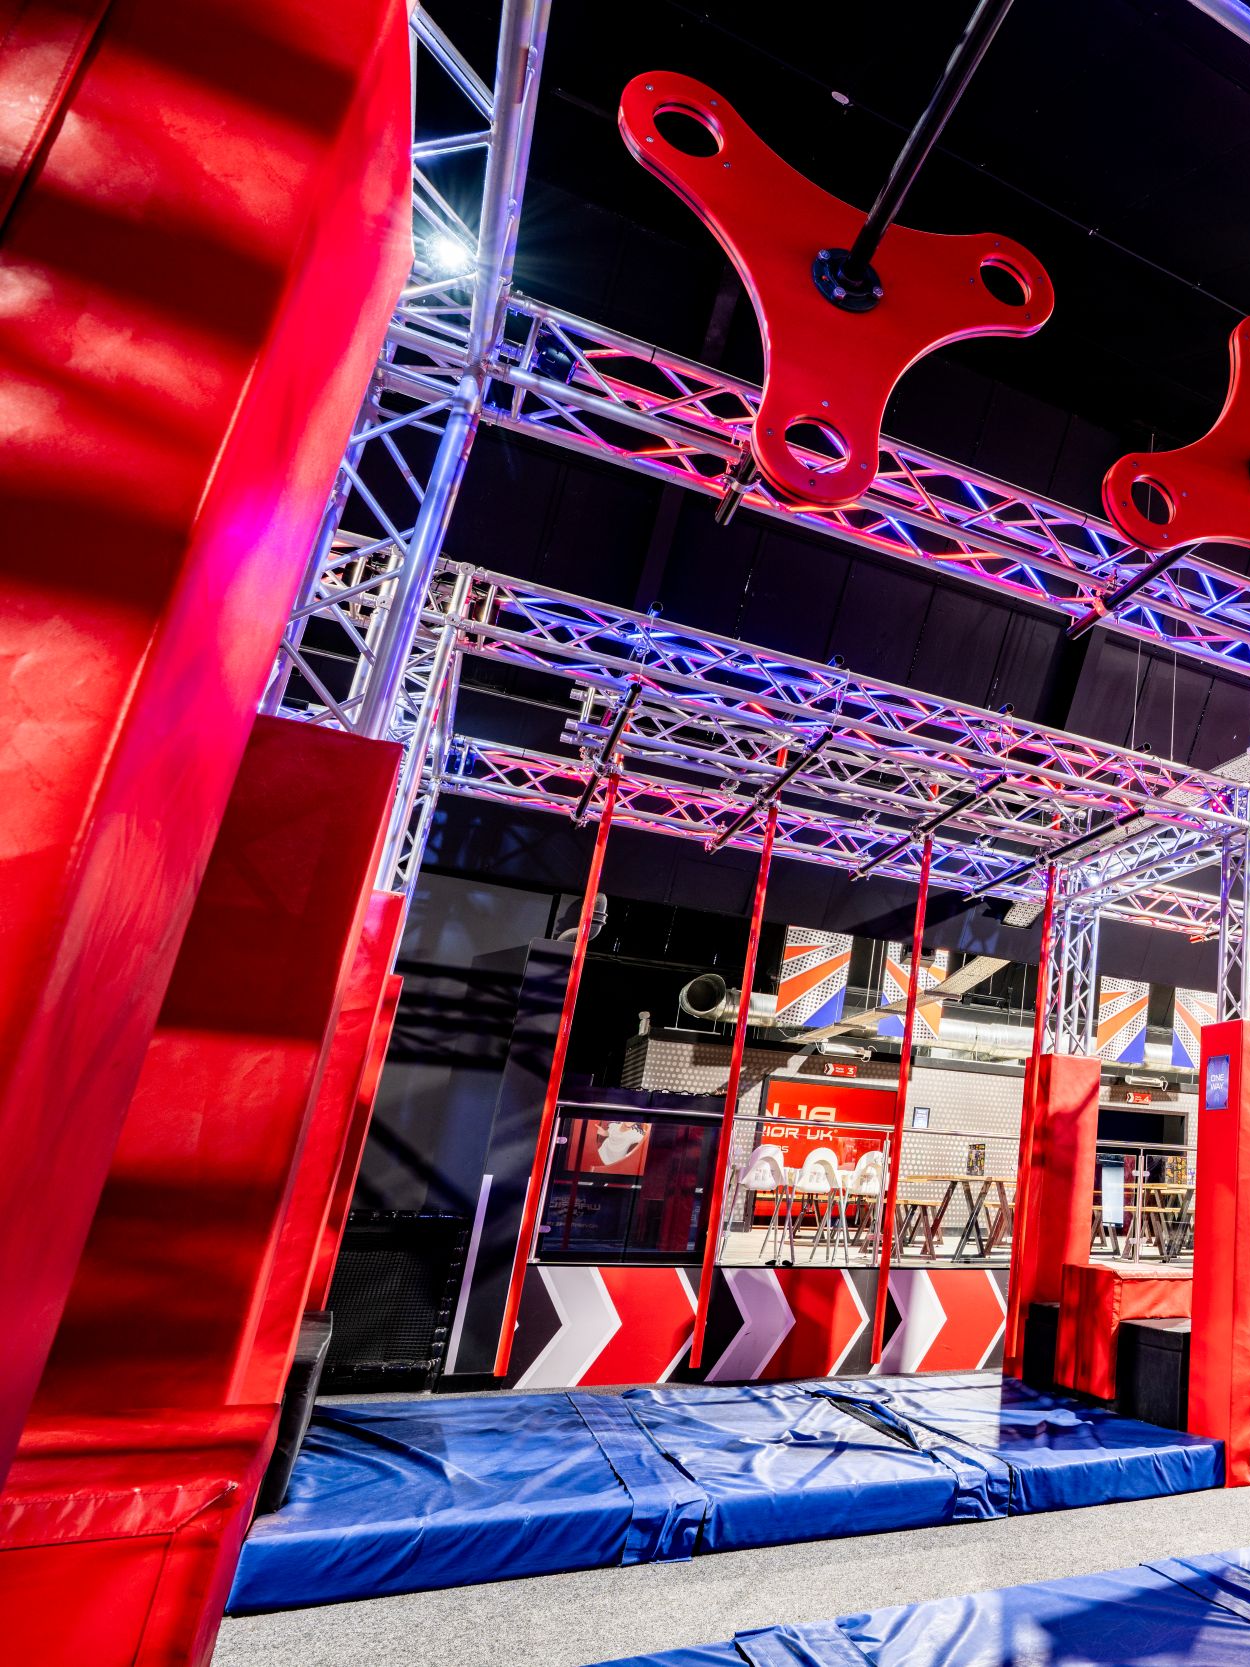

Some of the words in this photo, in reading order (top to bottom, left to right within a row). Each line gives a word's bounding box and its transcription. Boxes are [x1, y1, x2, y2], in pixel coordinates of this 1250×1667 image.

[847, 1067, 854, 1075] 3
[1210, 1073, 1225, 1082] ONE
[1210, 1082, 1225, 1090] WAY
